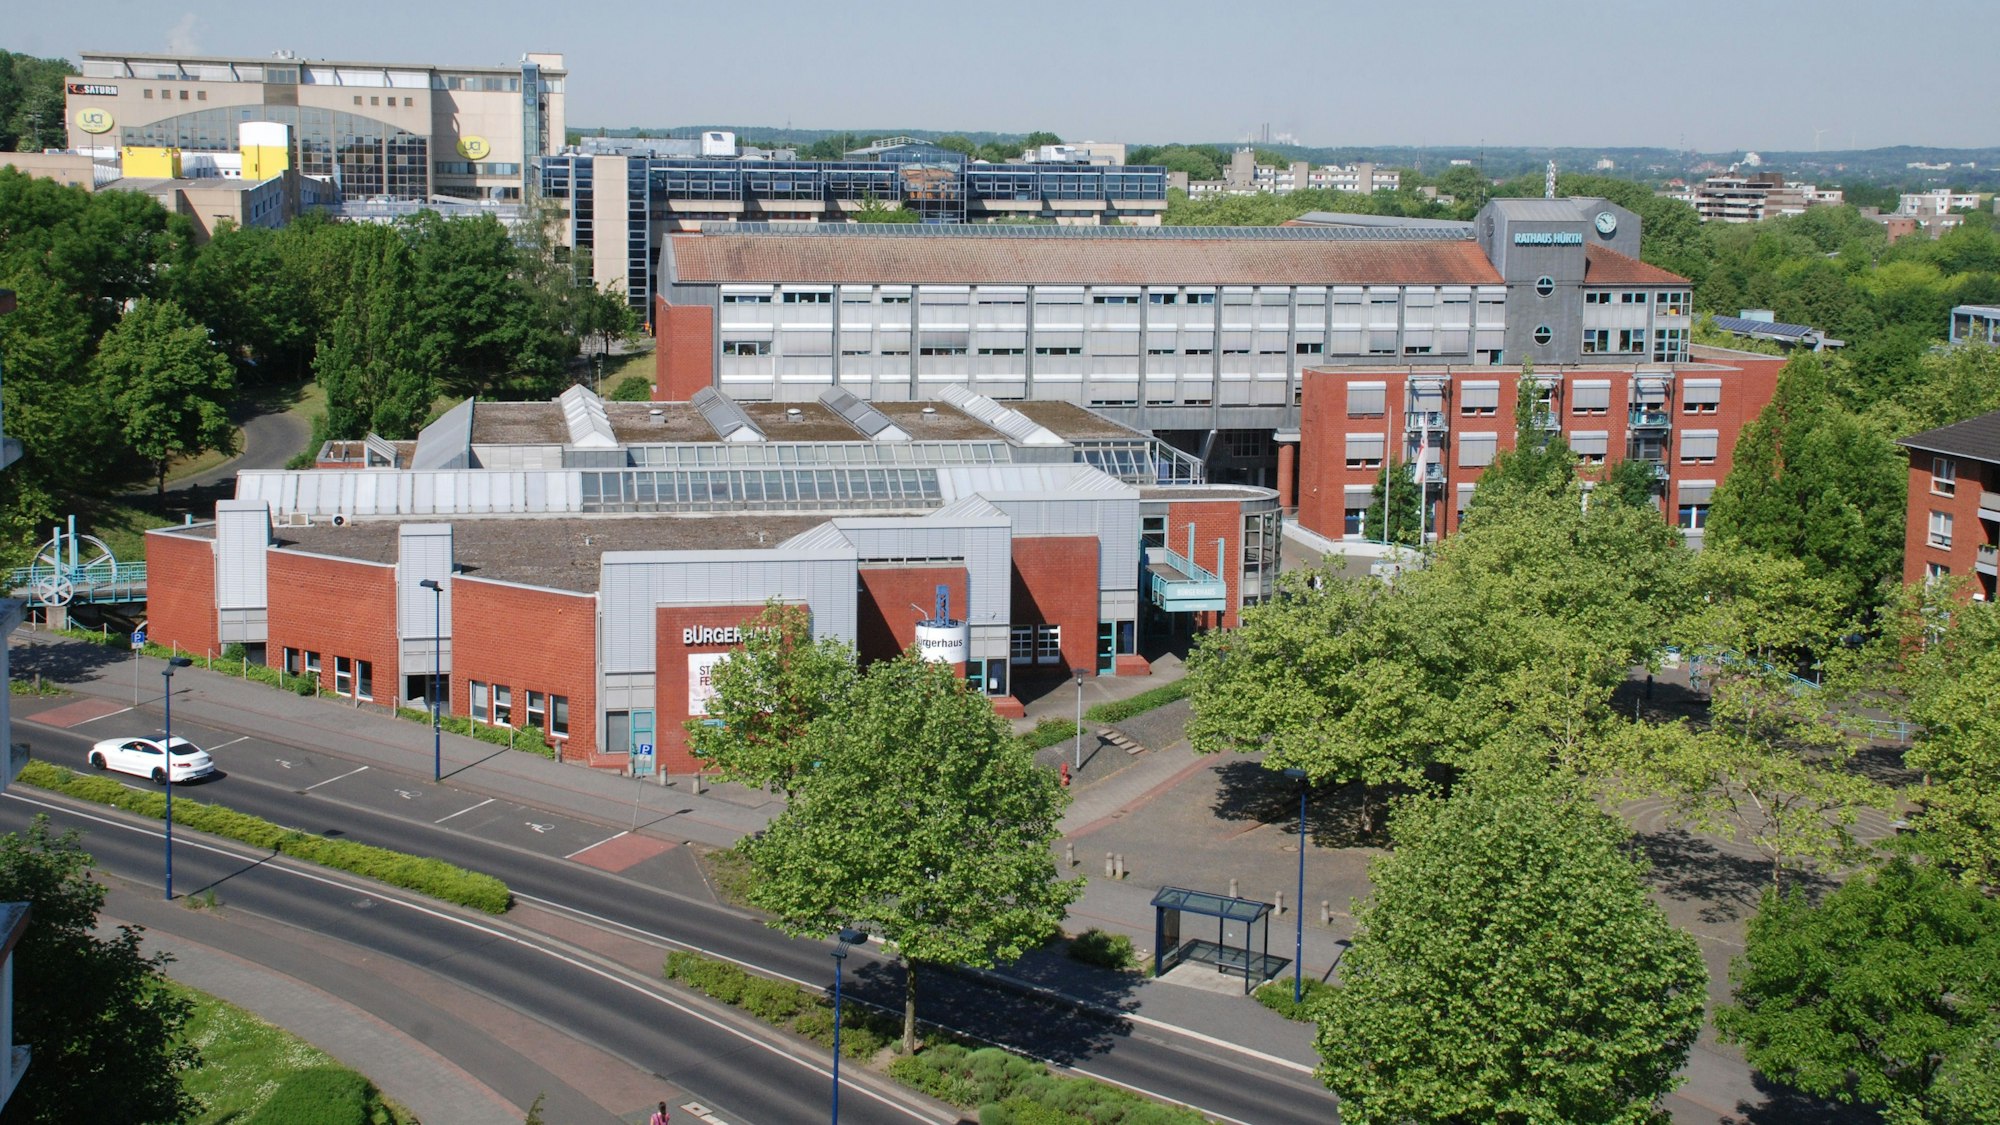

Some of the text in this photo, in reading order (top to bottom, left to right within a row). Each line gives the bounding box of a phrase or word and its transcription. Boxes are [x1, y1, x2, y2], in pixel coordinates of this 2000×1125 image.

[84, 85, 117, 95] SATURN
[82, 112, 103, 124] UCI
[1514, 231, 1582, 243] RATHAUS HÜRTH
[134, 633, 141, 642] P
[683, 624, 781, 644] BÜRGERU
[641, 744, 650, 754] P
